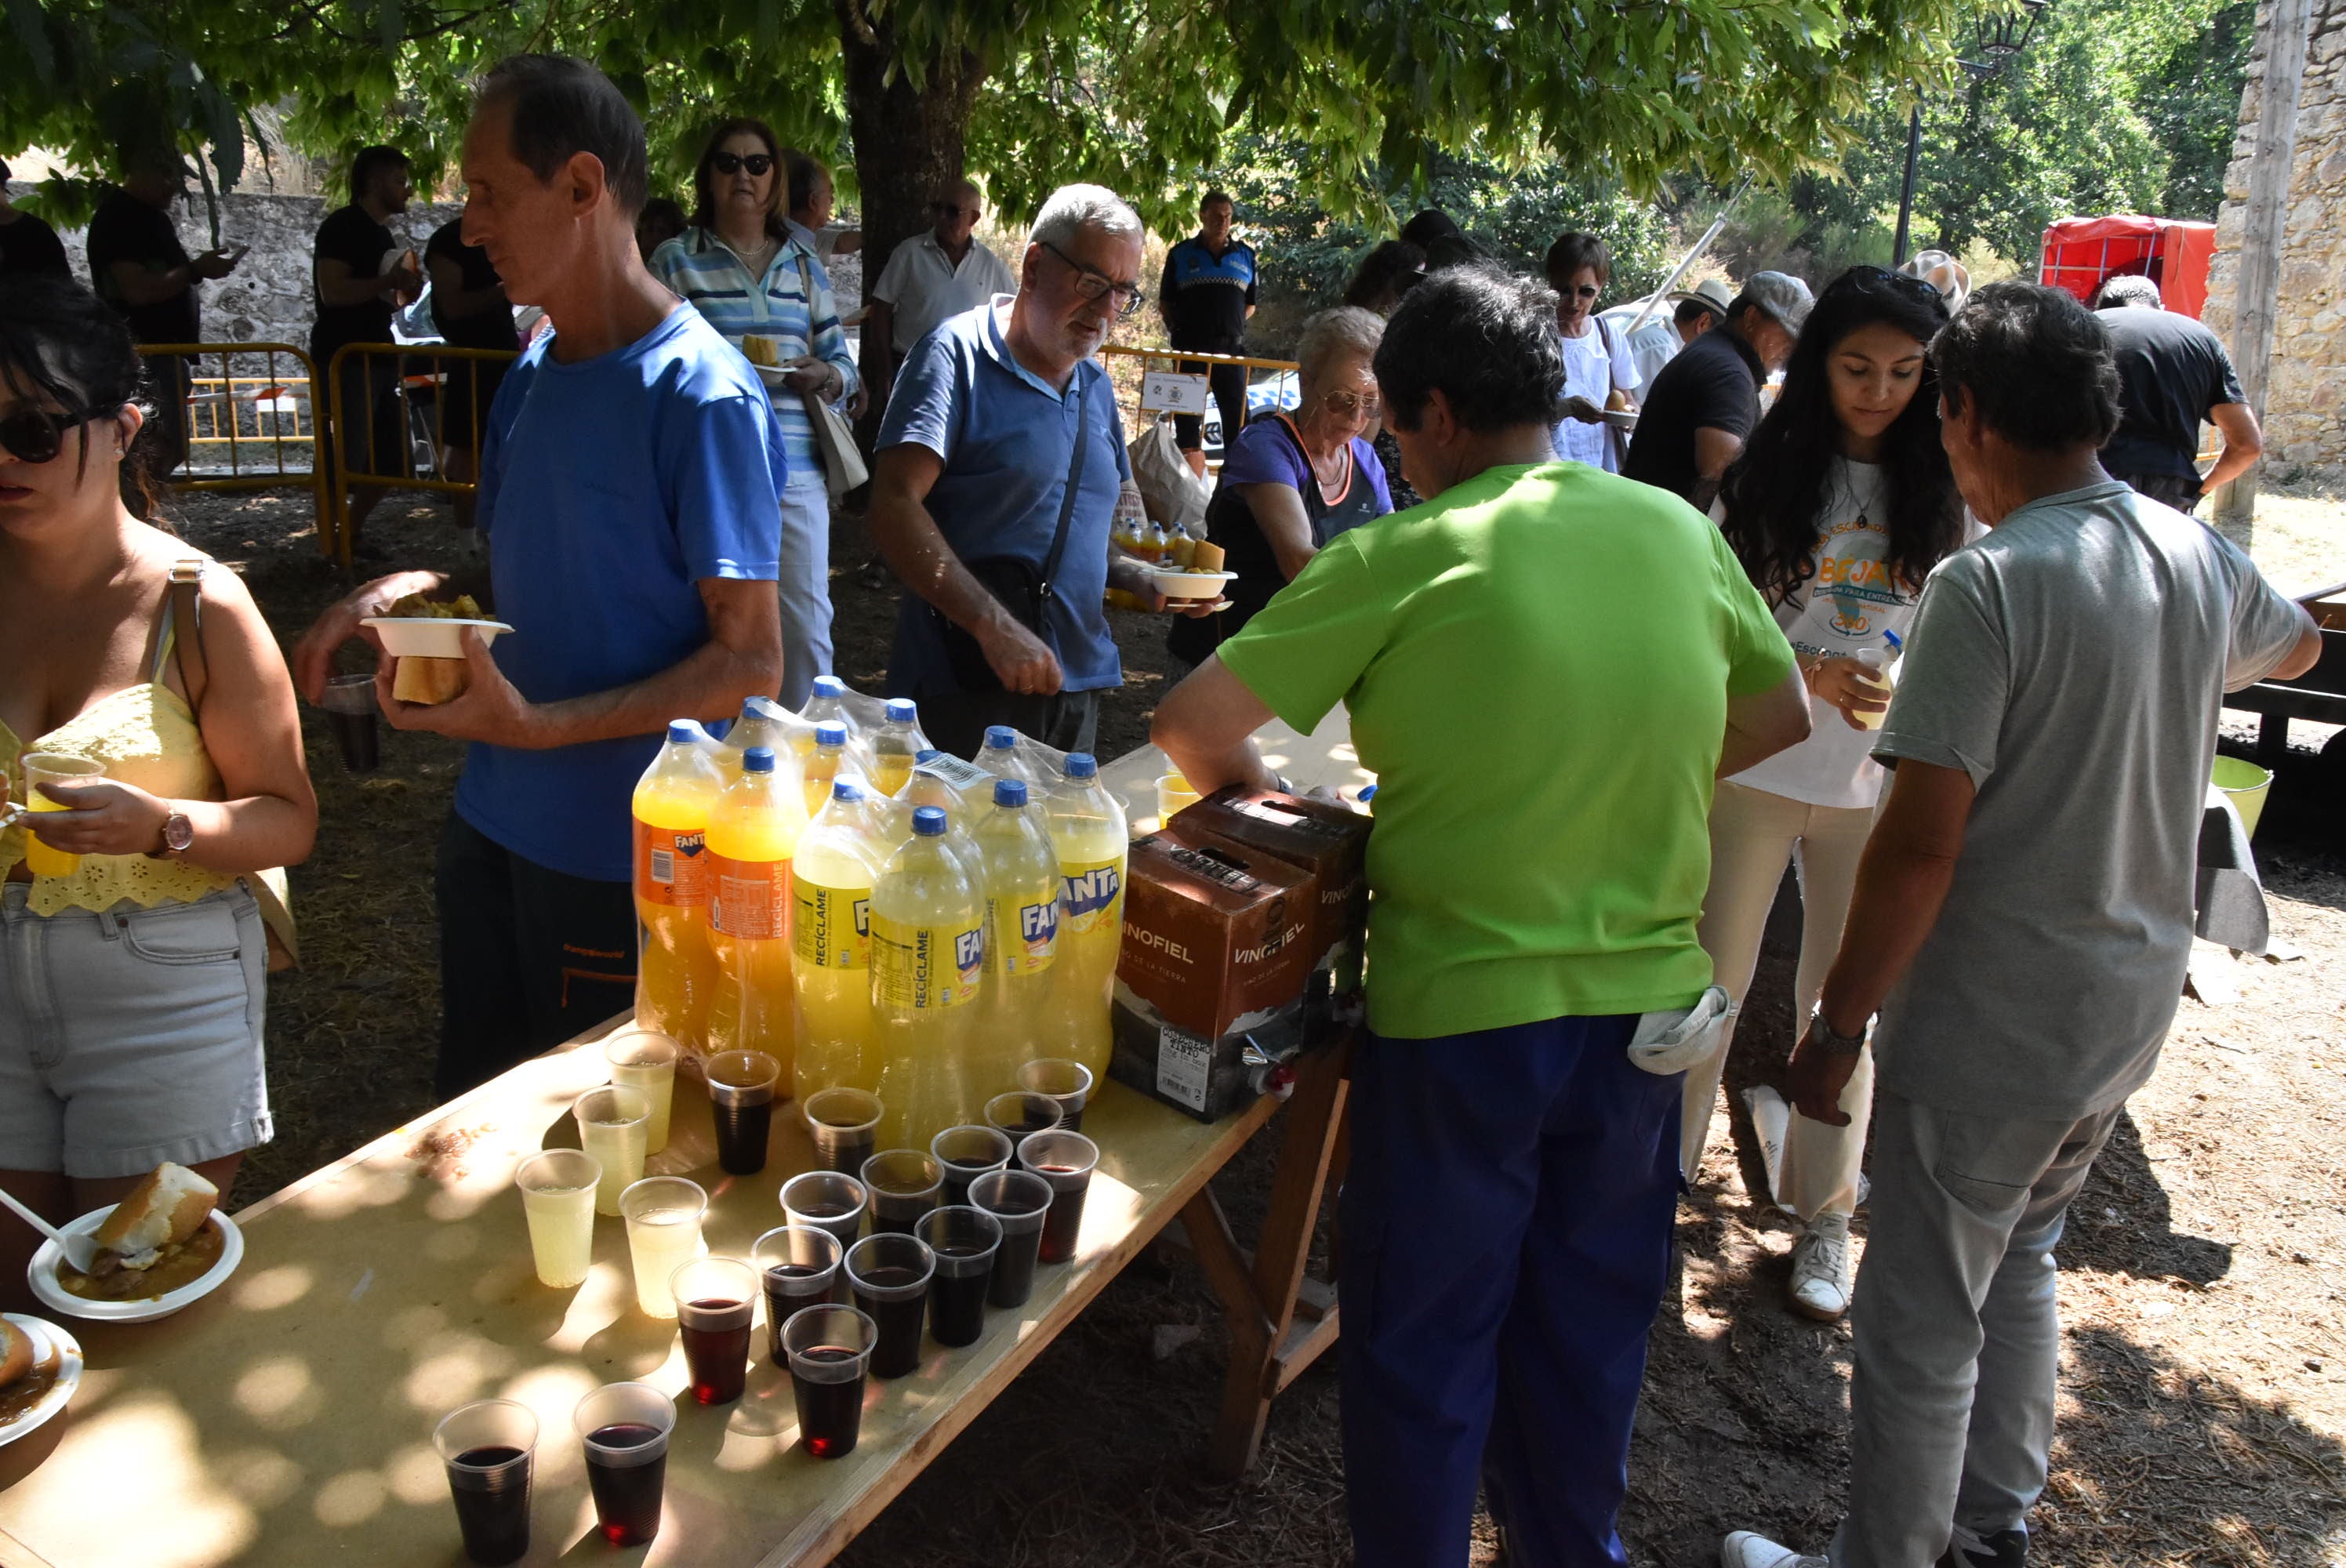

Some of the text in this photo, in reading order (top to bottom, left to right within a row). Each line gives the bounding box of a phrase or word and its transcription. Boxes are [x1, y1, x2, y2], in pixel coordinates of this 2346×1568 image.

[1834, 612, 1868, 630] 360
[674, 833, 705, 848] FANT
[1059, 866, 1119, 902] ANTA
[1022, 901, 1059, 936] FAN
[1123, 920, 1193, 964] INOFIEL
[1170, 1040, 1200, 1058] TINTO
